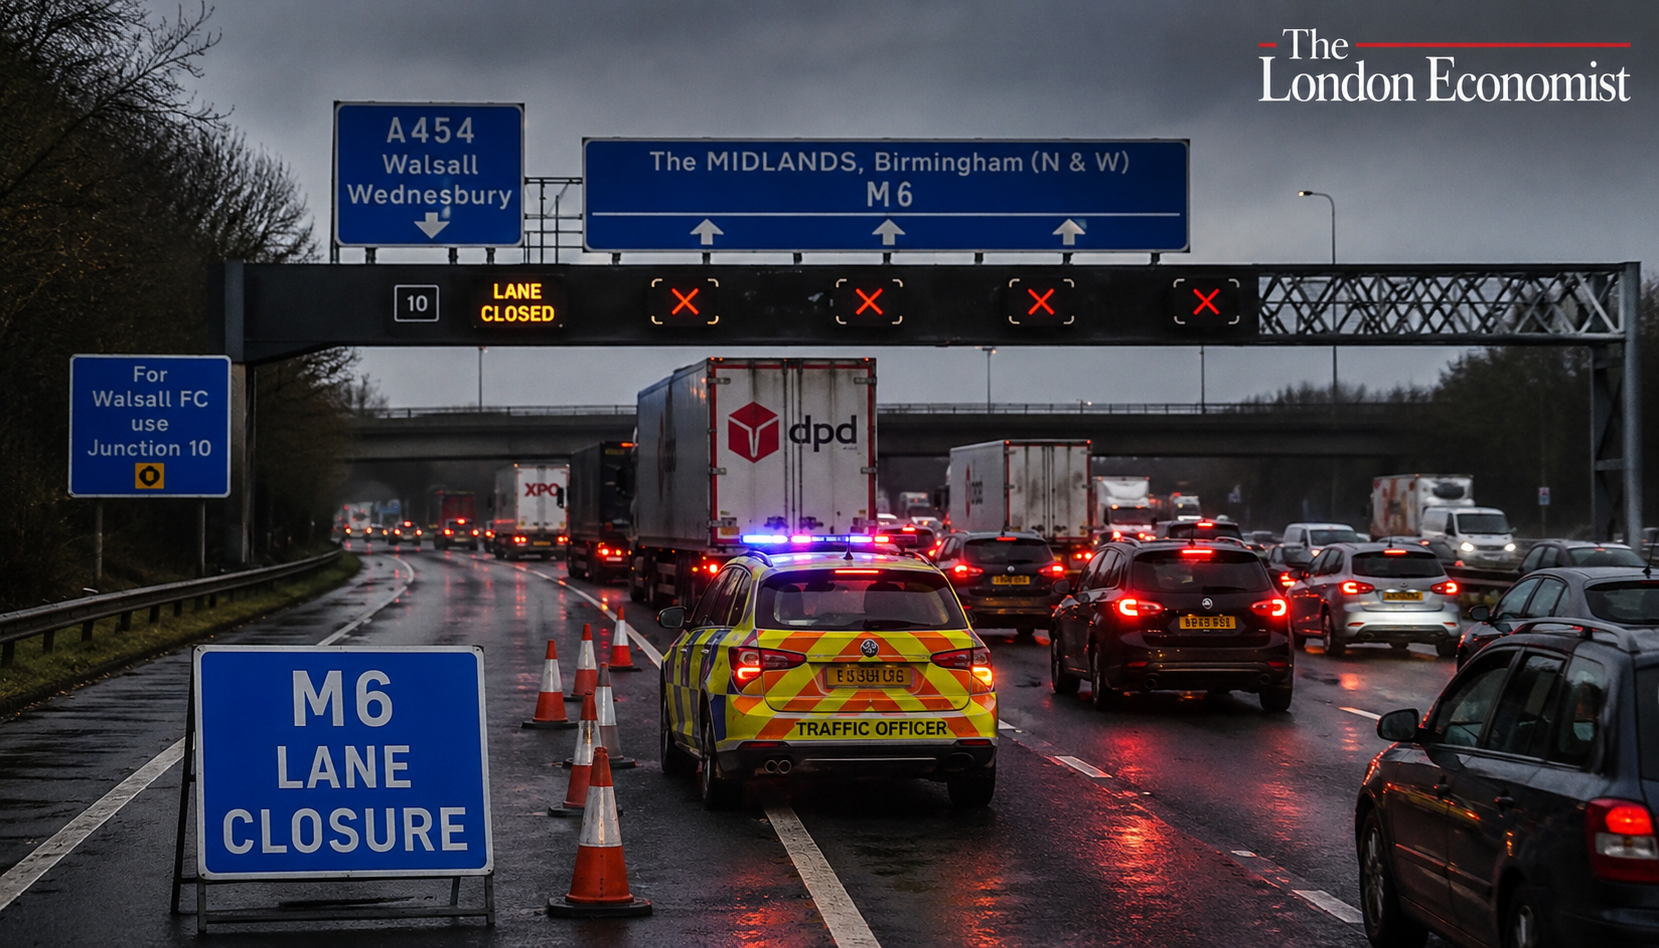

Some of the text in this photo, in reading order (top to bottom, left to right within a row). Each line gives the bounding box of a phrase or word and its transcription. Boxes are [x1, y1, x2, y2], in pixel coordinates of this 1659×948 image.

[387, 117, 475, 144] A454
[382, 154, 478, 175] Walsall
[650, 150, 1129, 177] The MIDLANDS, Birmingham (N & W)
[347, 184, 512, 210] Wednesbury
[867, 181, 913, 207] M6
[493, 282, 542, 300] LANE
[407, 295, 428, 312] 10
[481, 304, 555, 323] CLOSED
[134, 365, 168, 383] For
[92, 390, 209, 408] Walsall FC
[132, 418, 169, 432] use
[789, 415, 857, 452] dpd
[87, 439, 212, 457] Junction 10
[524, 482, 560, 497] XPO
[292, 669, 393, 727] M6
[795, 720, 948, 737] TRAFFIC OFFICER
[277, 744, 412, 789] LANE
[223, 806, 468, 855] CLOSURE
